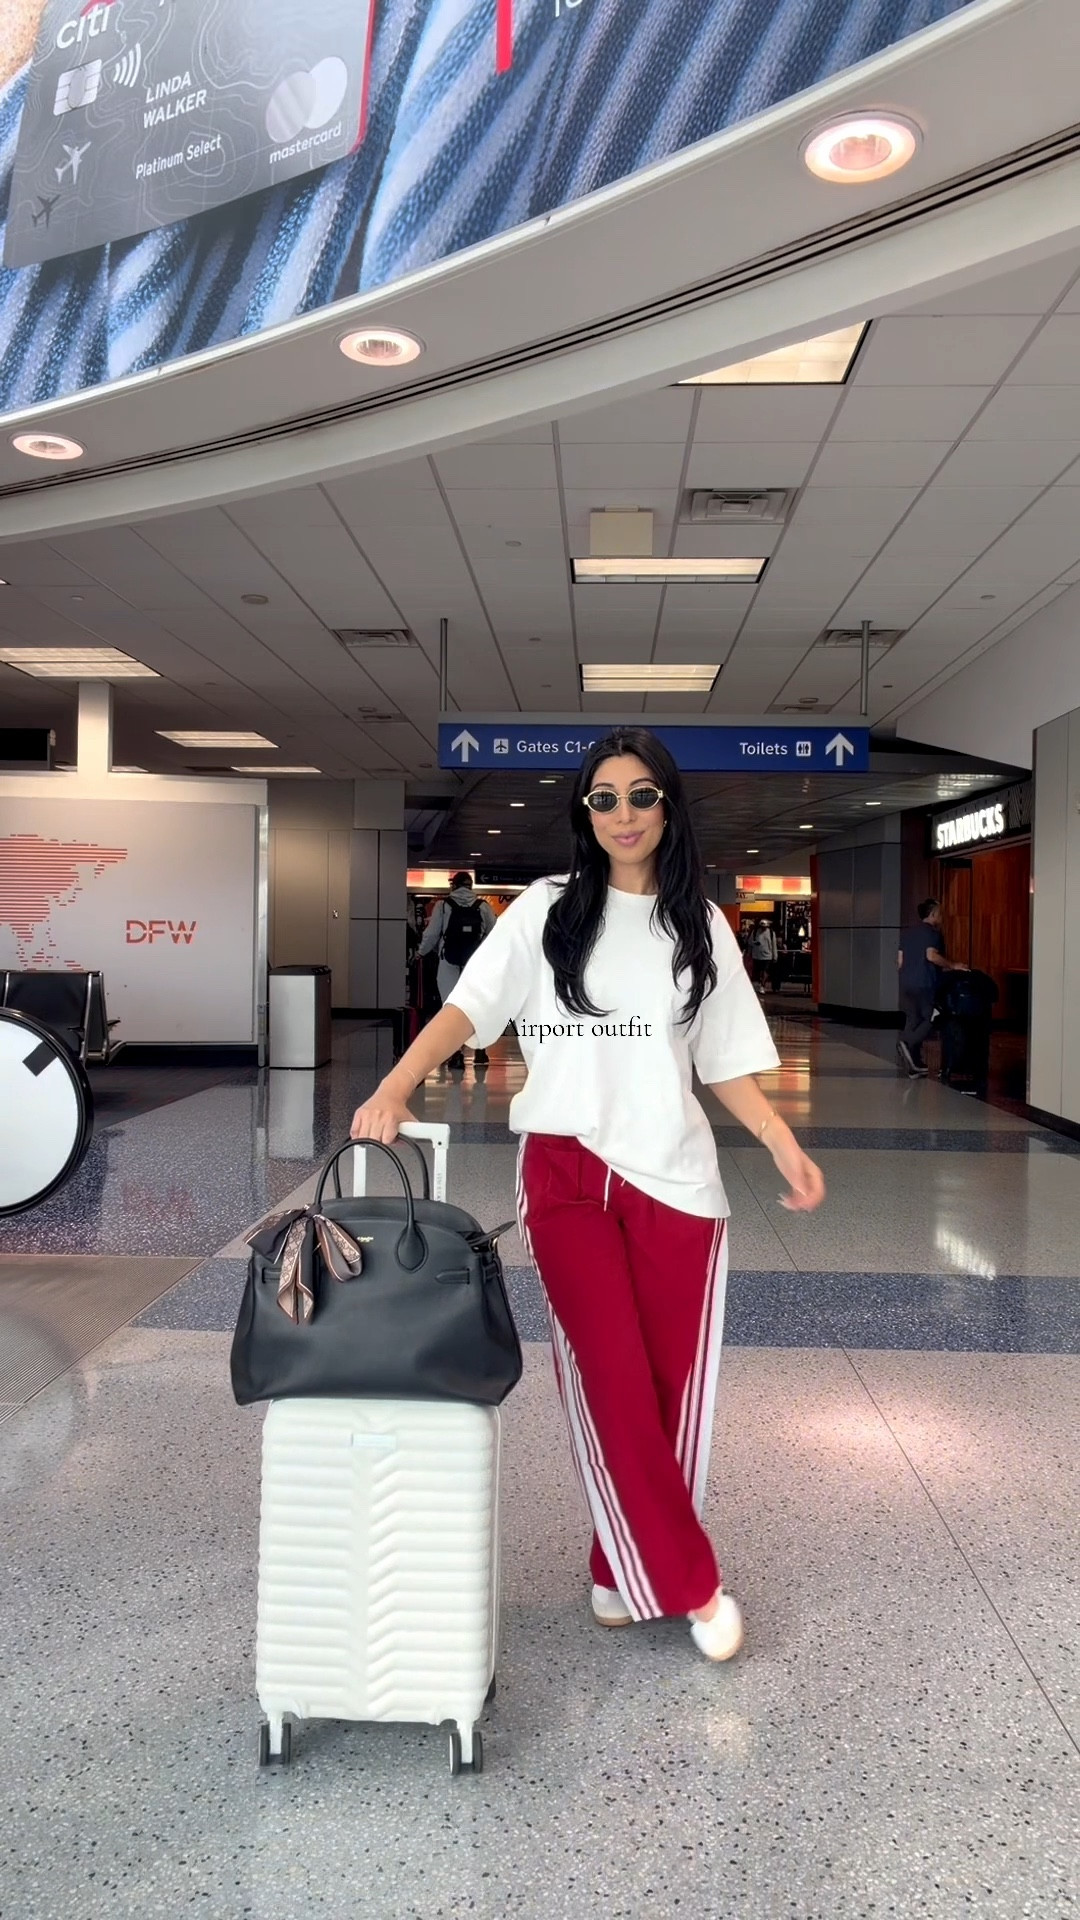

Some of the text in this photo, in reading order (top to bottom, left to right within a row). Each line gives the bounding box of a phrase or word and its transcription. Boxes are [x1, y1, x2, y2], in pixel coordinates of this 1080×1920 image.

[57, 4, 110, 48] citi
[145, 71, 192, 103] LINDA
[143, 89, 207, 128] WALKER
[136, 134, 222, 179] Platinum Select
[269, 121, 342, 164] mastercard
[516, 740, 559, 753] Gates
[739, 742, 788, 755] Toilets
[937, 803, 1004, 849] STARBUCKS
[126, 920, 197, 944] DFW
